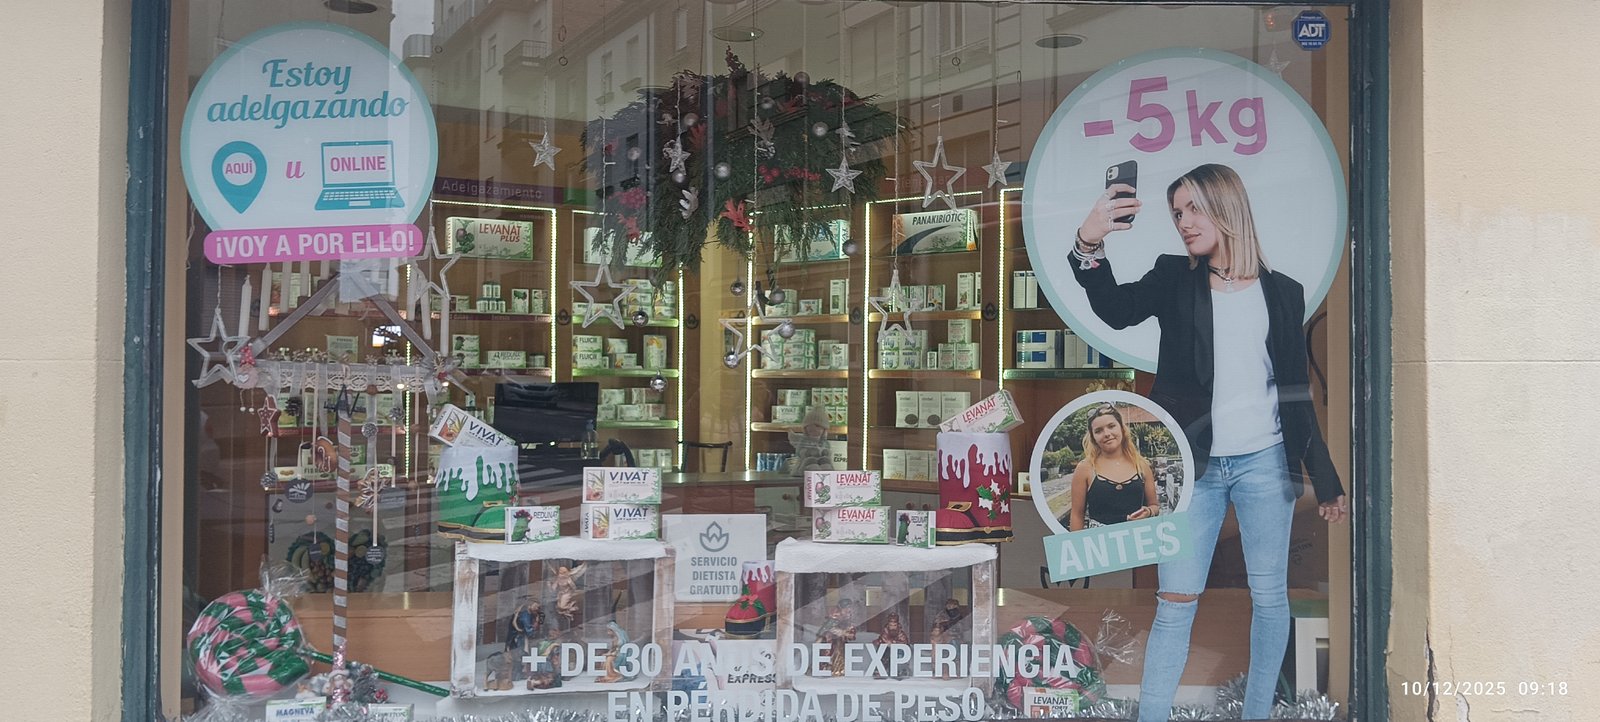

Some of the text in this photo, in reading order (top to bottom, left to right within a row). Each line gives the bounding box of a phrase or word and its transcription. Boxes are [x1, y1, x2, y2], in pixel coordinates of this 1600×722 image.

[1298, 23, 1326, 37] ADT
[262, 58, 352, 95] Estoy
[207, 90, 410, 129] adelgazando
[1083, 76, 1268, 155] -5 kg
[286, 160, 305, 179] u
[330, 156, 386, 172] ONLINE
[442, 180, 542, 198] Adelgazamiento
[912, 213, 962, 225] PANAKIBIOTIC
[216, 230, 415, 258] ¡VOY A POR ELLO!
[500, 235, 520, 243] PLUS
[469, 421, 504, 446] VIVAT
[609, 472, 649, 481] VIVAT
[613, 508, 649, 517] VIVAT
[1059, 521, 1181, 575] ANTES
[690, 557, 737, 566] SERVICIO
[692, 571, 736, 580] DIETISTA
[690, 585, 738, 595] GRATUITO
[561, 643, 607, 677] DE
[619, 643, 663, 677] 30
[674, 633, 773, 677] AÑS
[788, 643, 832, 677] DE
[845, 643, 1079, 678] EXPERIENCIA
[608, 682, 985, 722] EN PÉRDIDA DE PESO
